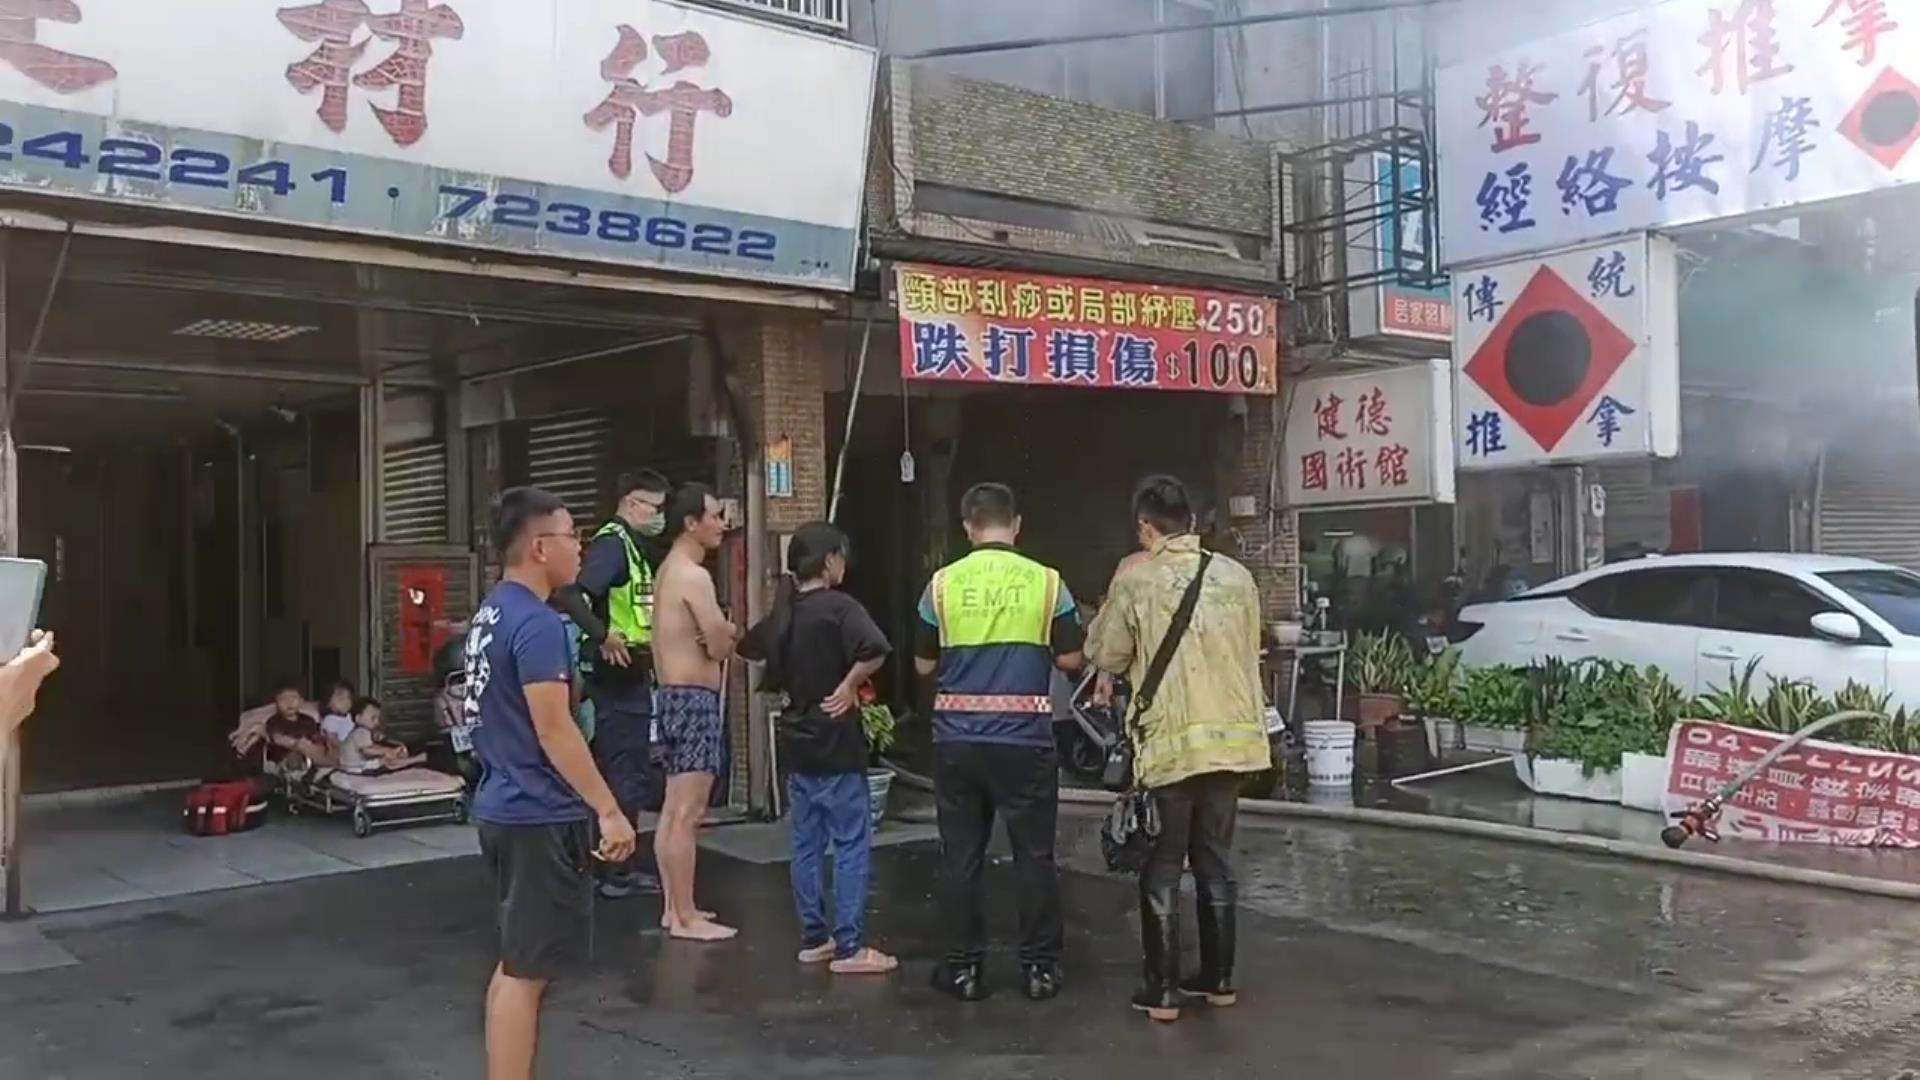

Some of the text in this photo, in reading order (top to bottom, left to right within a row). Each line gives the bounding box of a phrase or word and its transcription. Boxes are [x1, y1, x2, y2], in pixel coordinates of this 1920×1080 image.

[0, 121, 777, 262] 42241 7238622
[1475, 96, 1822, 234] 經絡按摩
[1313, 386, 1393, 441] 健德
[1301, 446, 1409, 491] 國術館
[961, 584, 1026, 608] EMT
